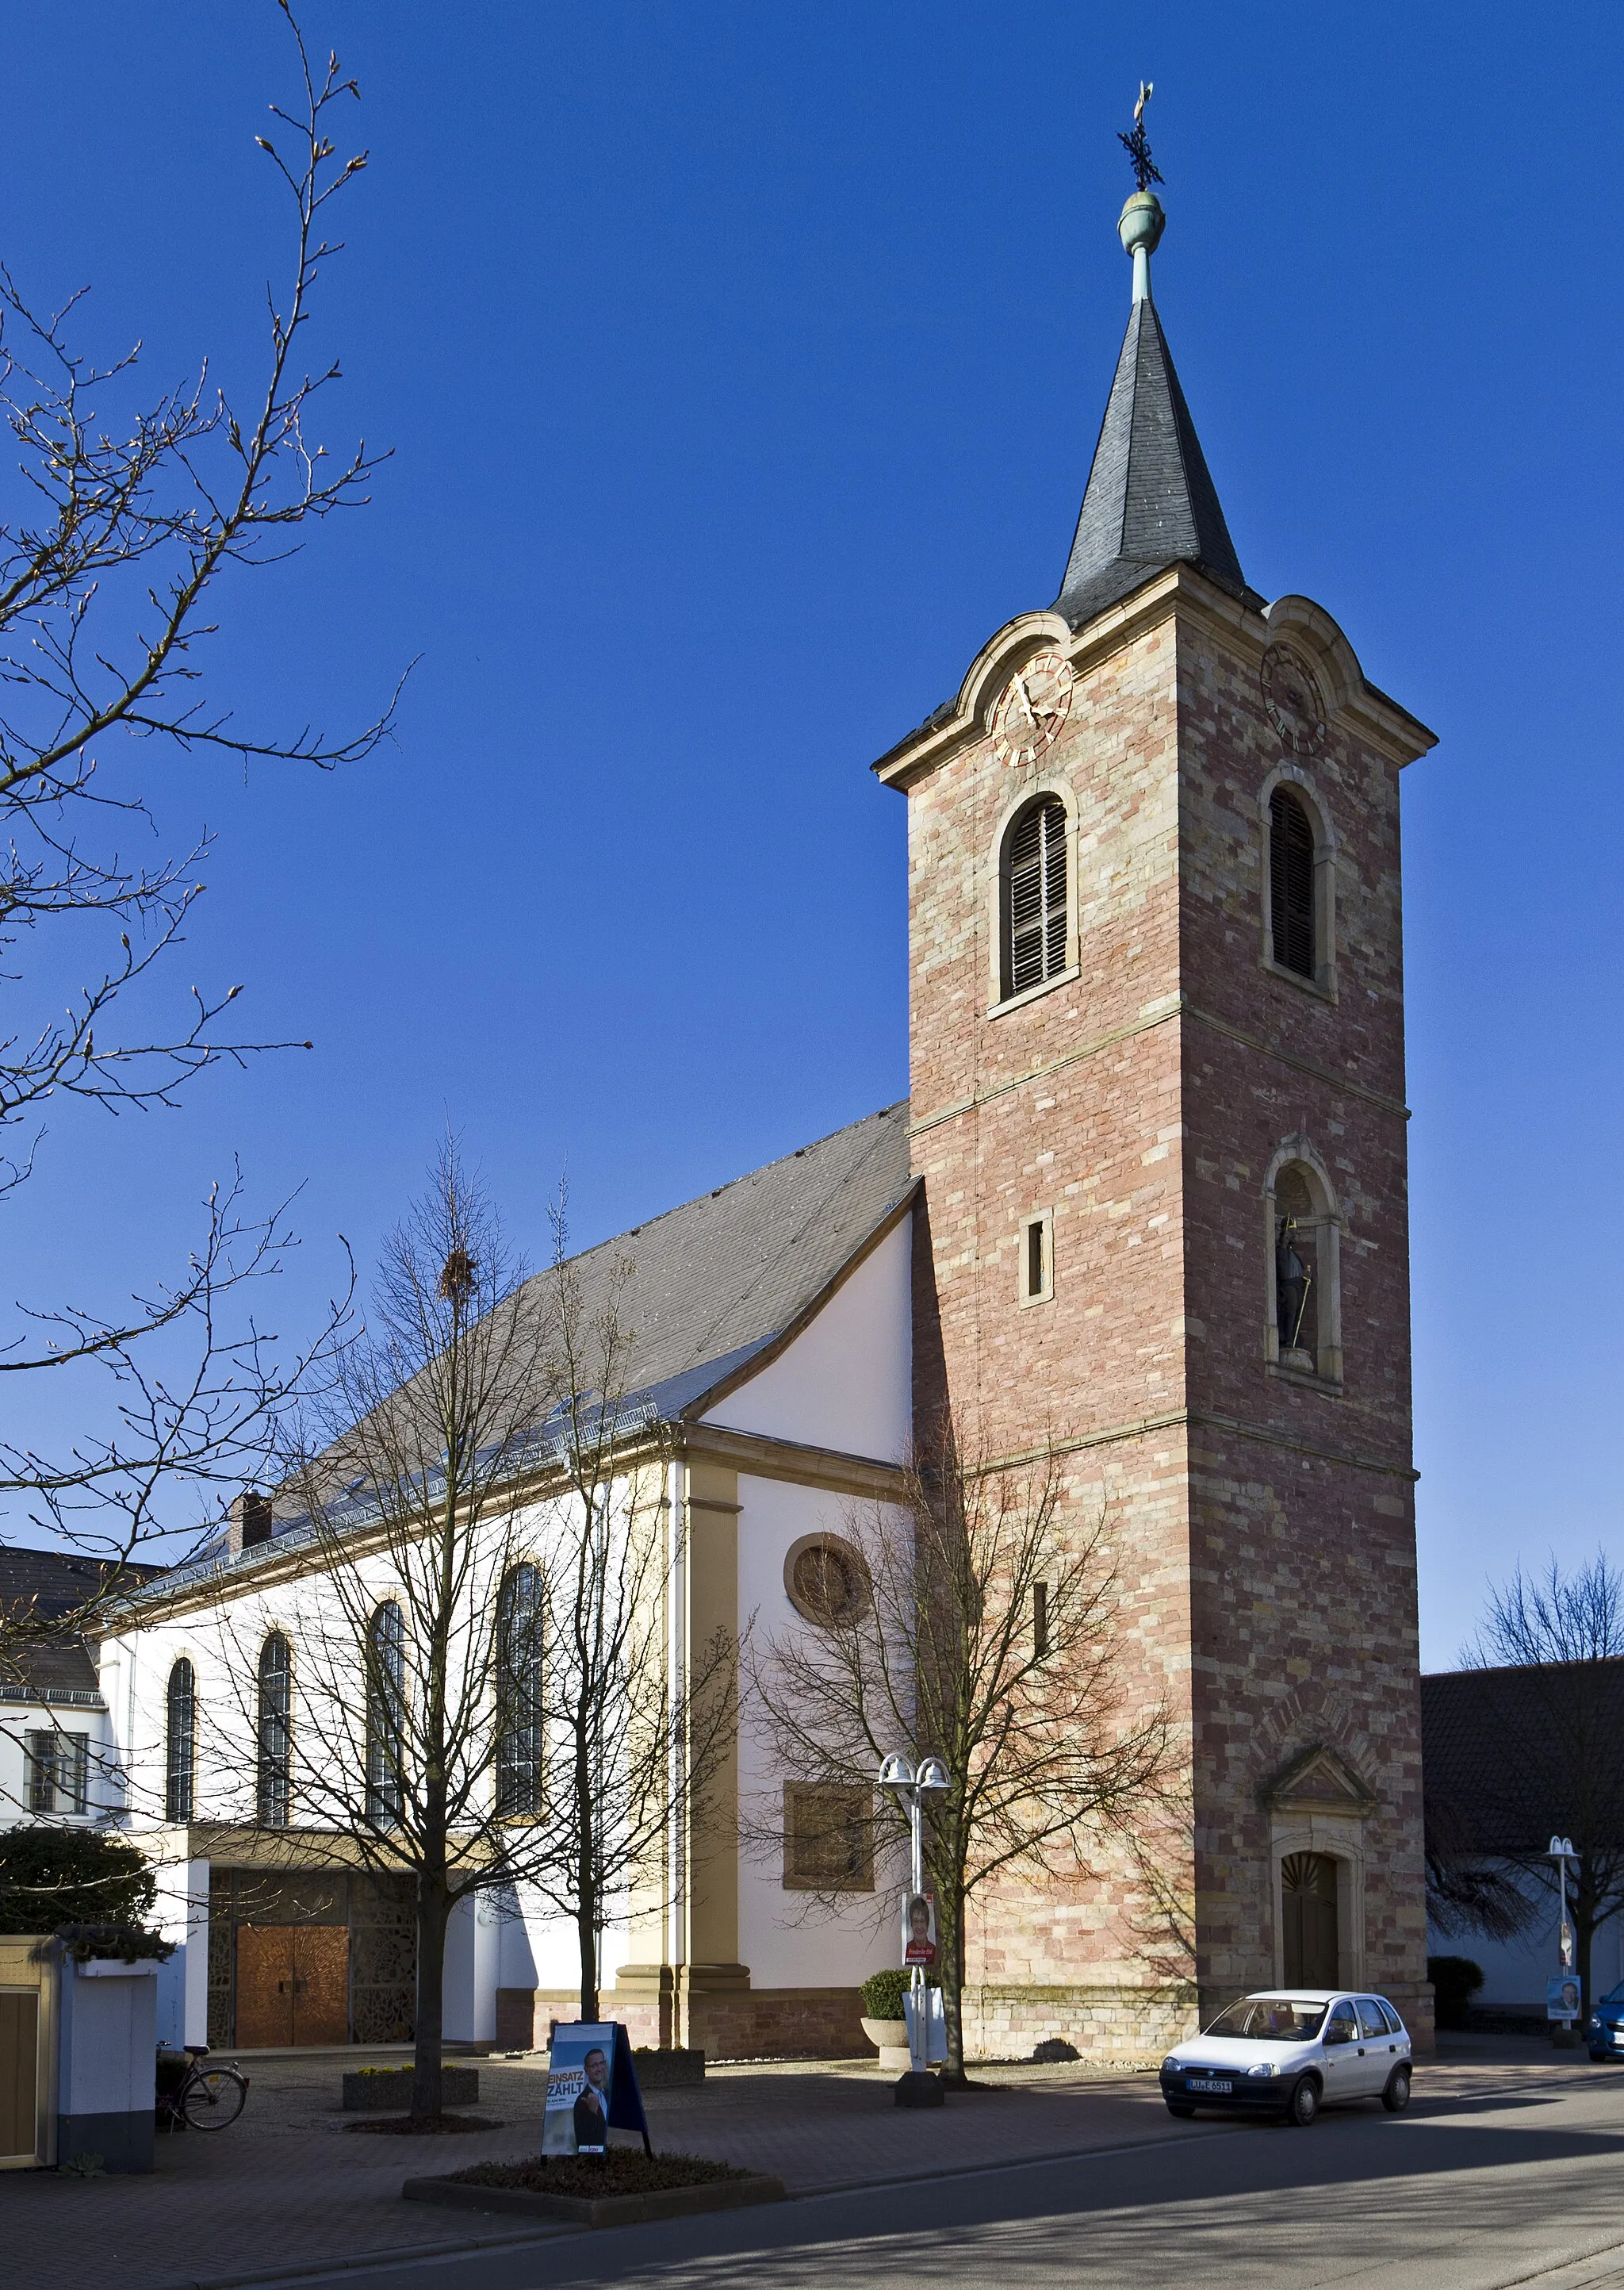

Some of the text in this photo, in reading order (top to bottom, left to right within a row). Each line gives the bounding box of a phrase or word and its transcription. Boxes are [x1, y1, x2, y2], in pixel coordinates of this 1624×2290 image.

[549, 2071, 584, 2084] EINSATZ
[547, 2082, 583, 2096] ZÄHLT
[1212, 2081, 1231, 2091] 6511
